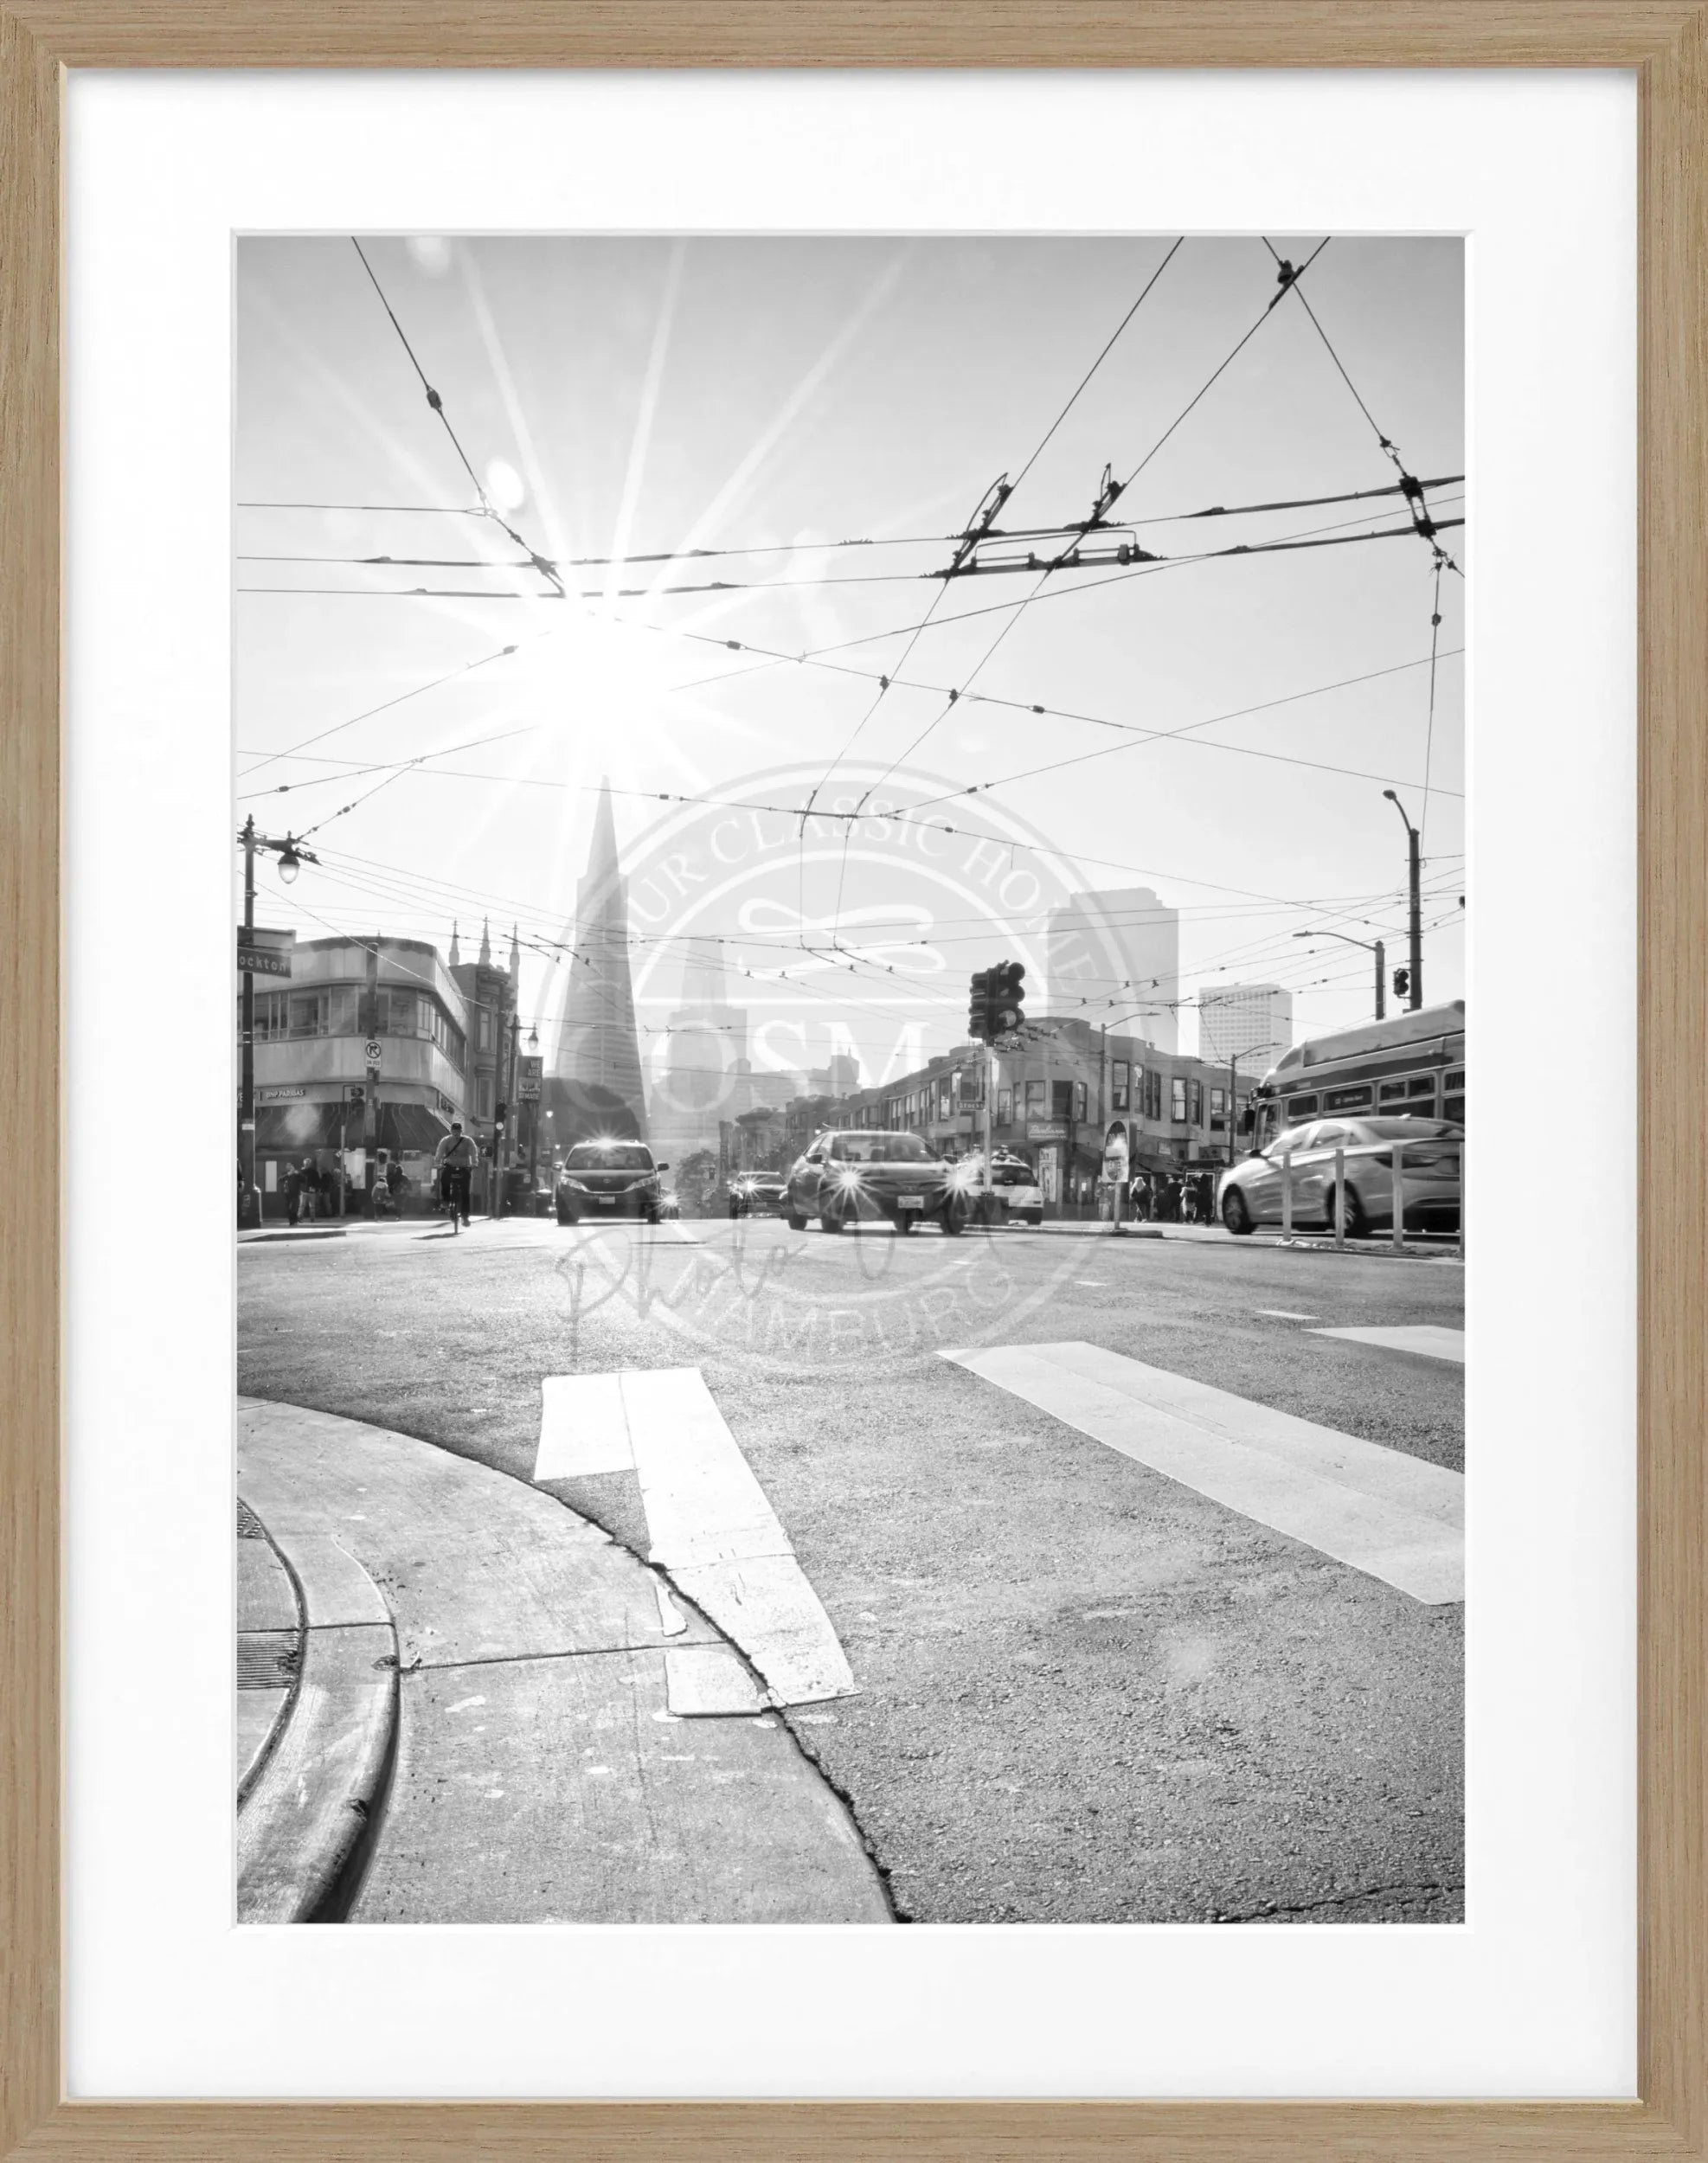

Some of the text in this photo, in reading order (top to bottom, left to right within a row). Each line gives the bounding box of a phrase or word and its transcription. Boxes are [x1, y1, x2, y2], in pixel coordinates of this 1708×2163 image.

[239, 955, 287, 972] ockton
[530, 1060, 541, 1069] WE
[527, 1069, 541, 1077] ARE
